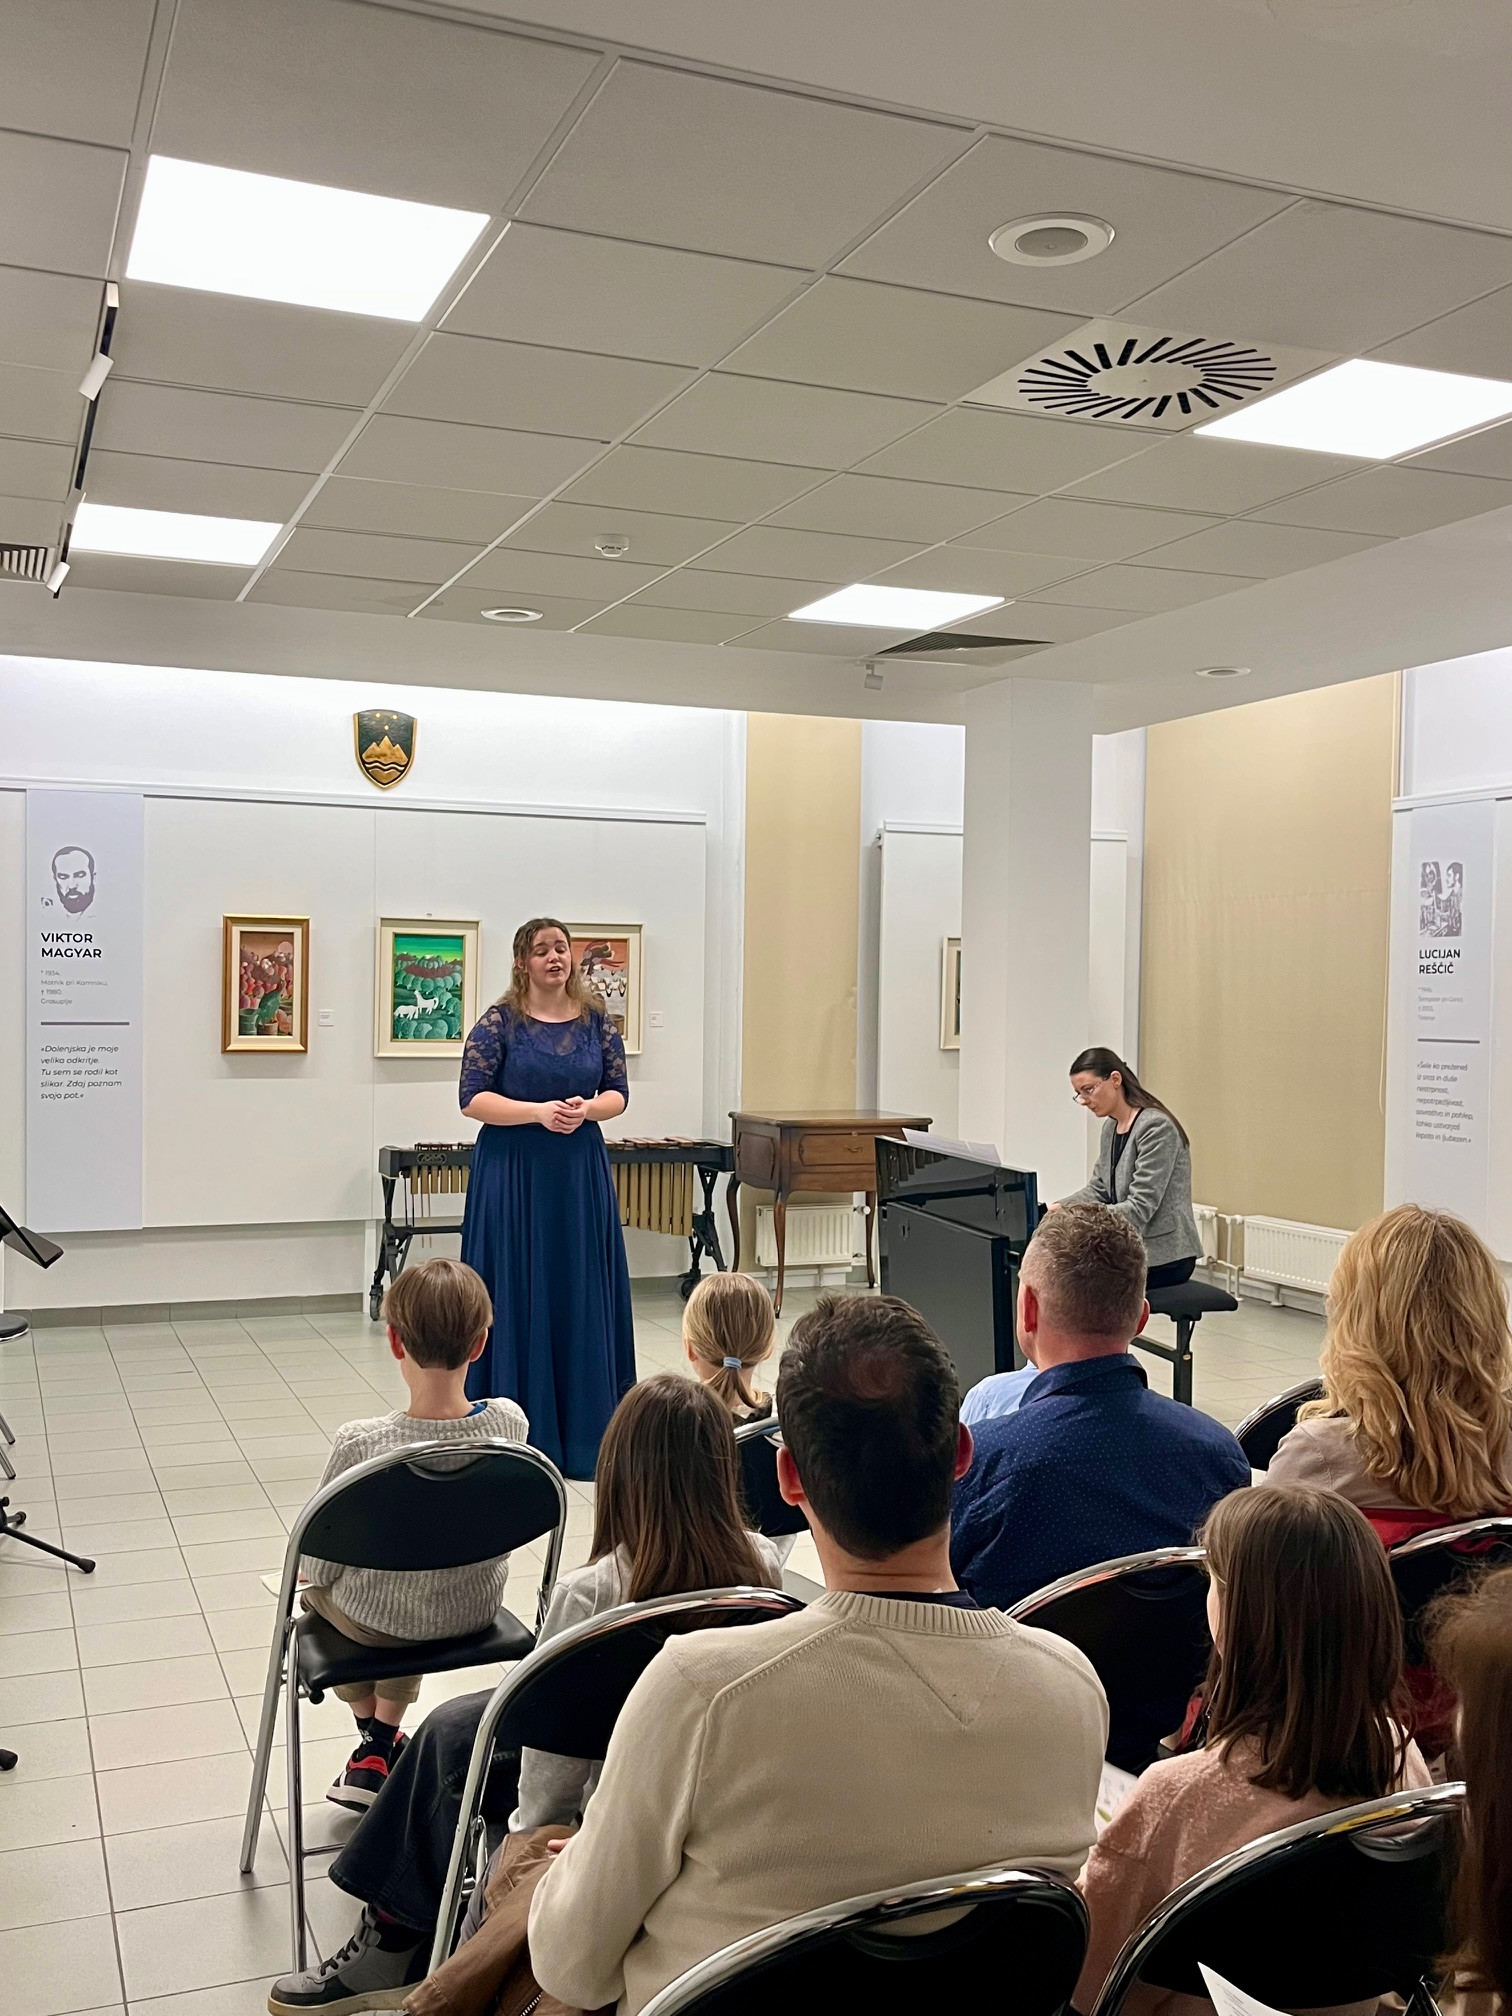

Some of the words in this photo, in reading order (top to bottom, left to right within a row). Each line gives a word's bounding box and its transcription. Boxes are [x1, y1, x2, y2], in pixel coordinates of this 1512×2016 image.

[41, 932, 93, 943] VIKTOR
[41, 948, 102, 958] MAGYAR
[1419, 949, 1460, 959] LUCIJAN
[1419, 961, 1454, 974] REŠČIČ
[66, 1080, 86, 1088] Zdaj
[41, 1092, 62, 1100] svojo
